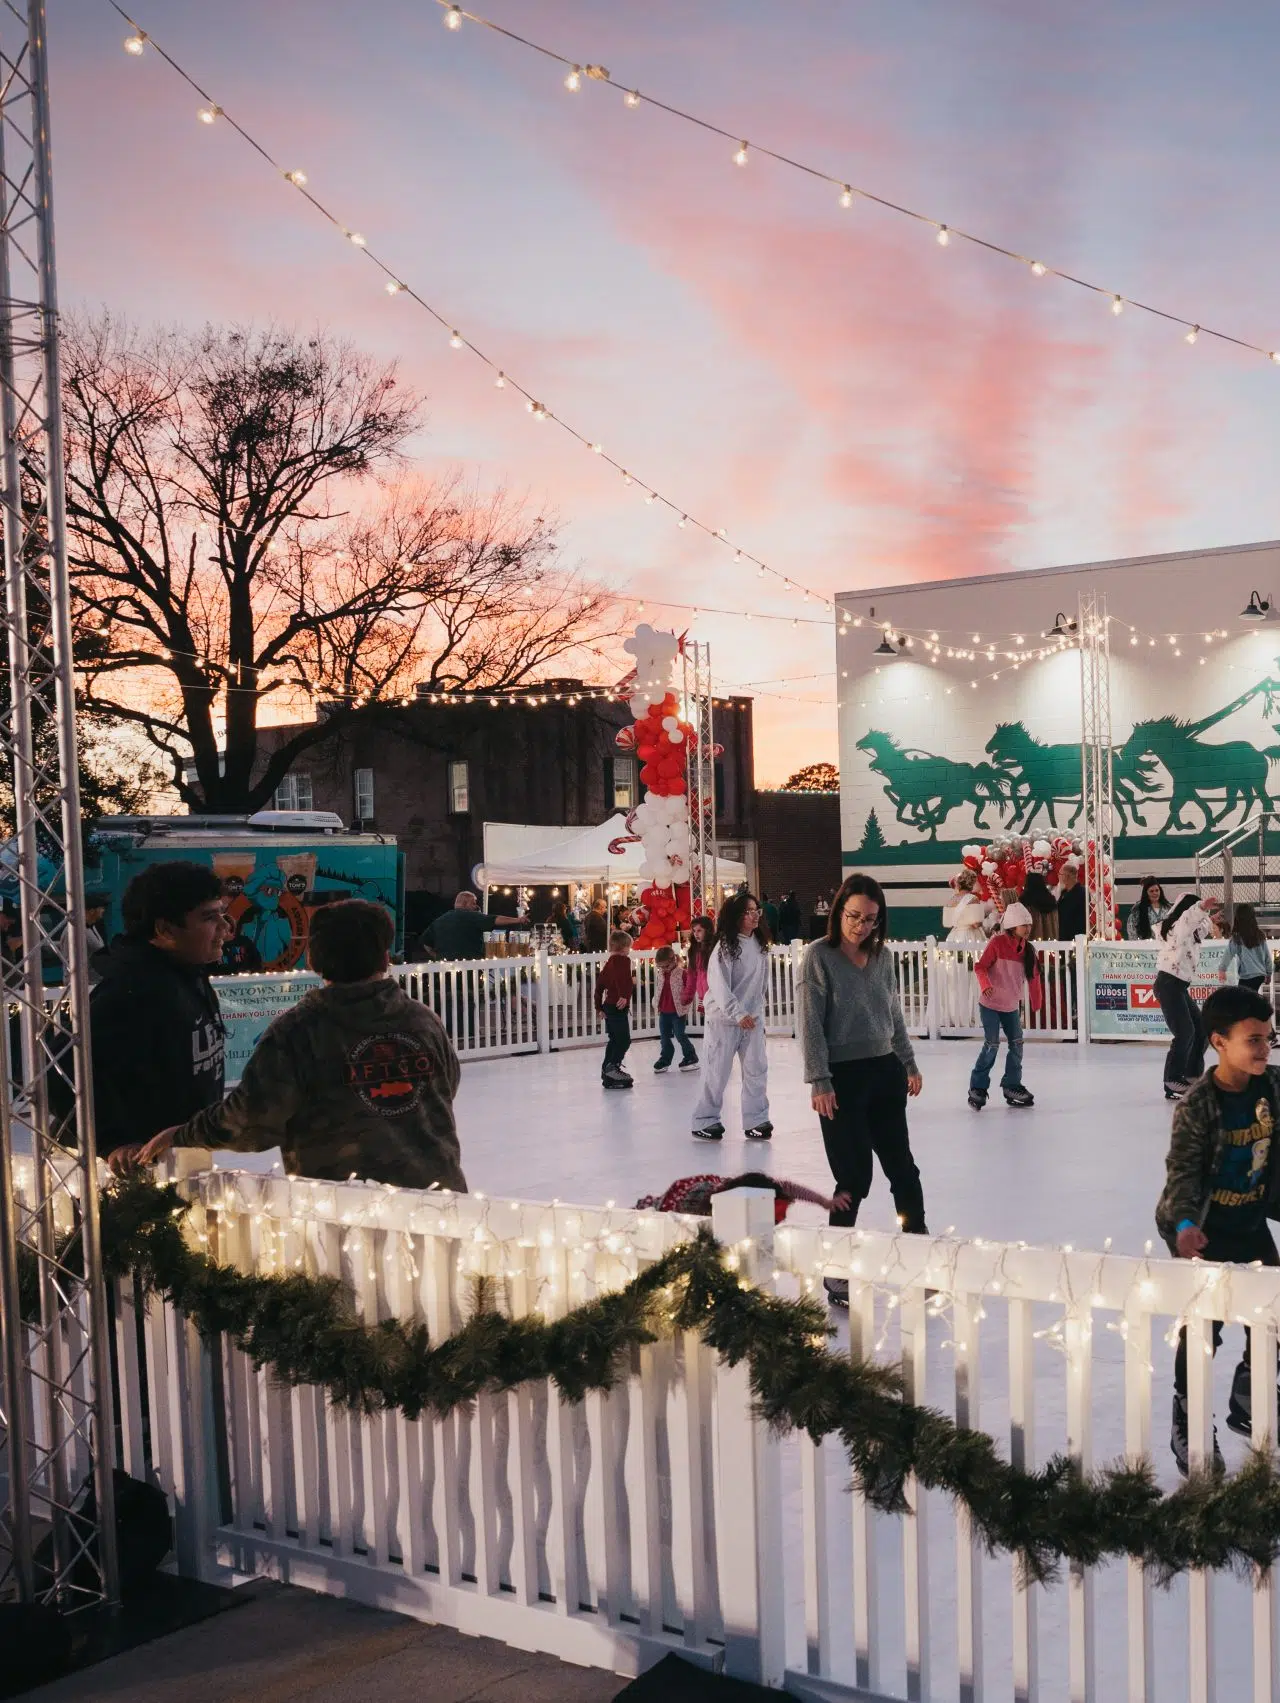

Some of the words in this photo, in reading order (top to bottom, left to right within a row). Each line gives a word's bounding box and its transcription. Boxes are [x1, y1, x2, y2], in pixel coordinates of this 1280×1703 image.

[218, 986, 277, 998] WNTOWN
[1096, 988, 1127, 997] DUBOSE
[222, 1012, 247, 1020] THANK
[249, 1010, 265, 1018] YOU
[351, 1033, 386, 1061] AMERICAN
[388, 1032, 422, 1051] FISHING
[349, 1056, 431, 1081] AFTCO
[381, 1081, 426, 1118] COMPANY
